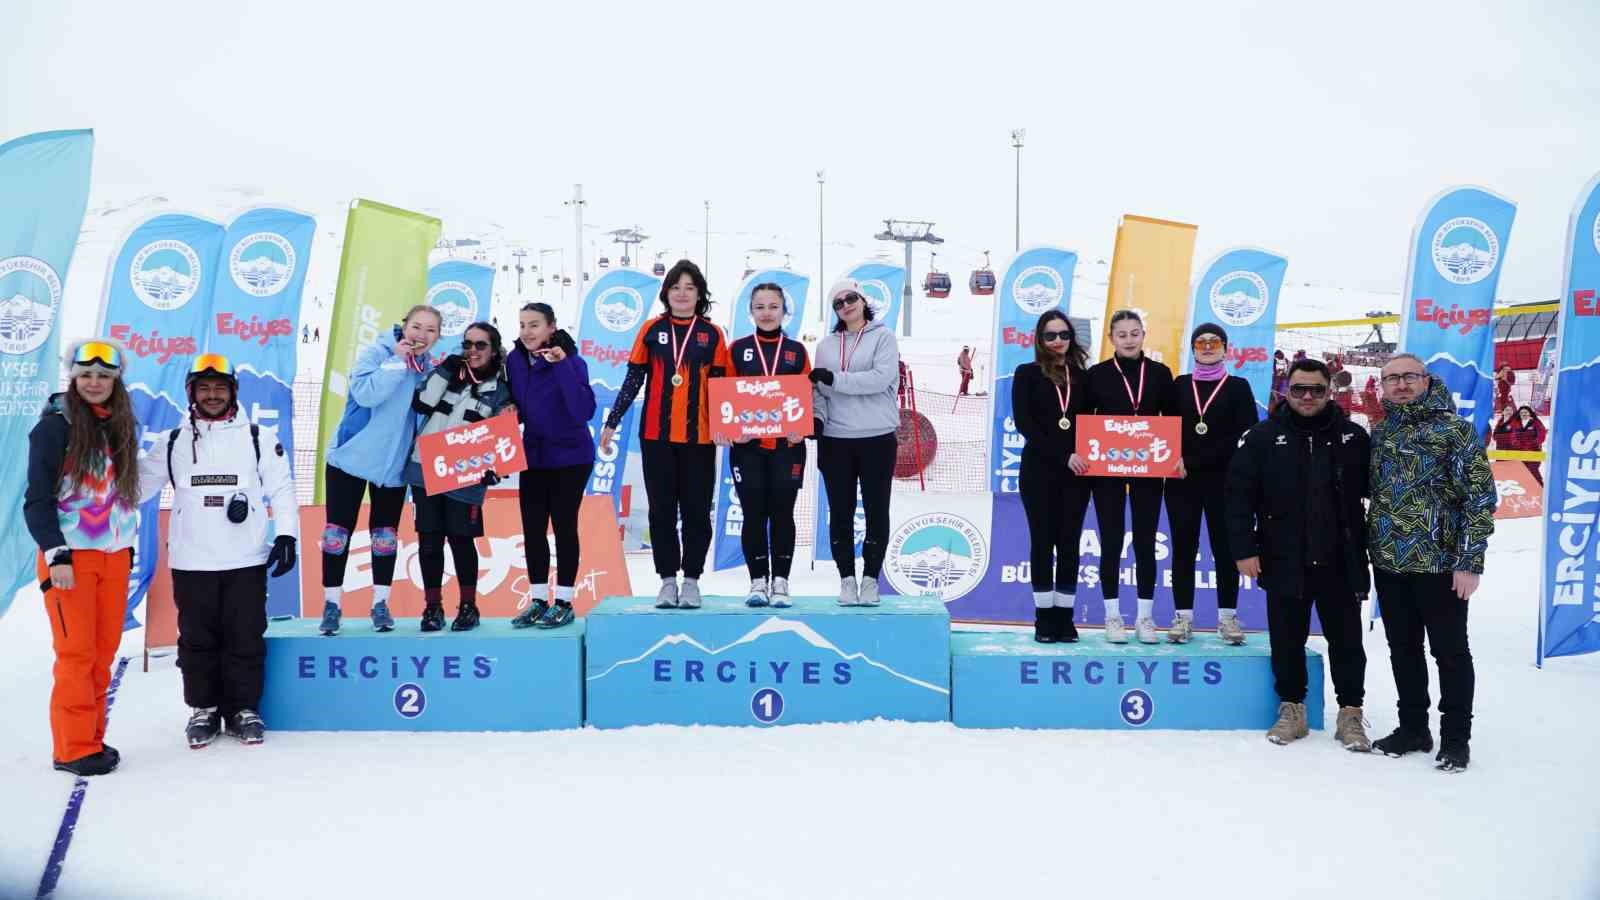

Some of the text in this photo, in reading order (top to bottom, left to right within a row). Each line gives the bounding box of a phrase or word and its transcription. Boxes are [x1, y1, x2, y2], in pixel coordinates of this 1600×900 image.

[215, 312, 292, 347] Erciyes
[657, 331, 669, 345] 8
[580, 339, 633, 368] Erciye
[743, 348, 754, 362] 6
[1103, 418, 1150, 437] Erciyes
[733, 467, 742, 483] 6
[401, 689, 419, 713] 2
[759, 694, 772, 717] 1
[1126, 696, 1145, 721] 3
